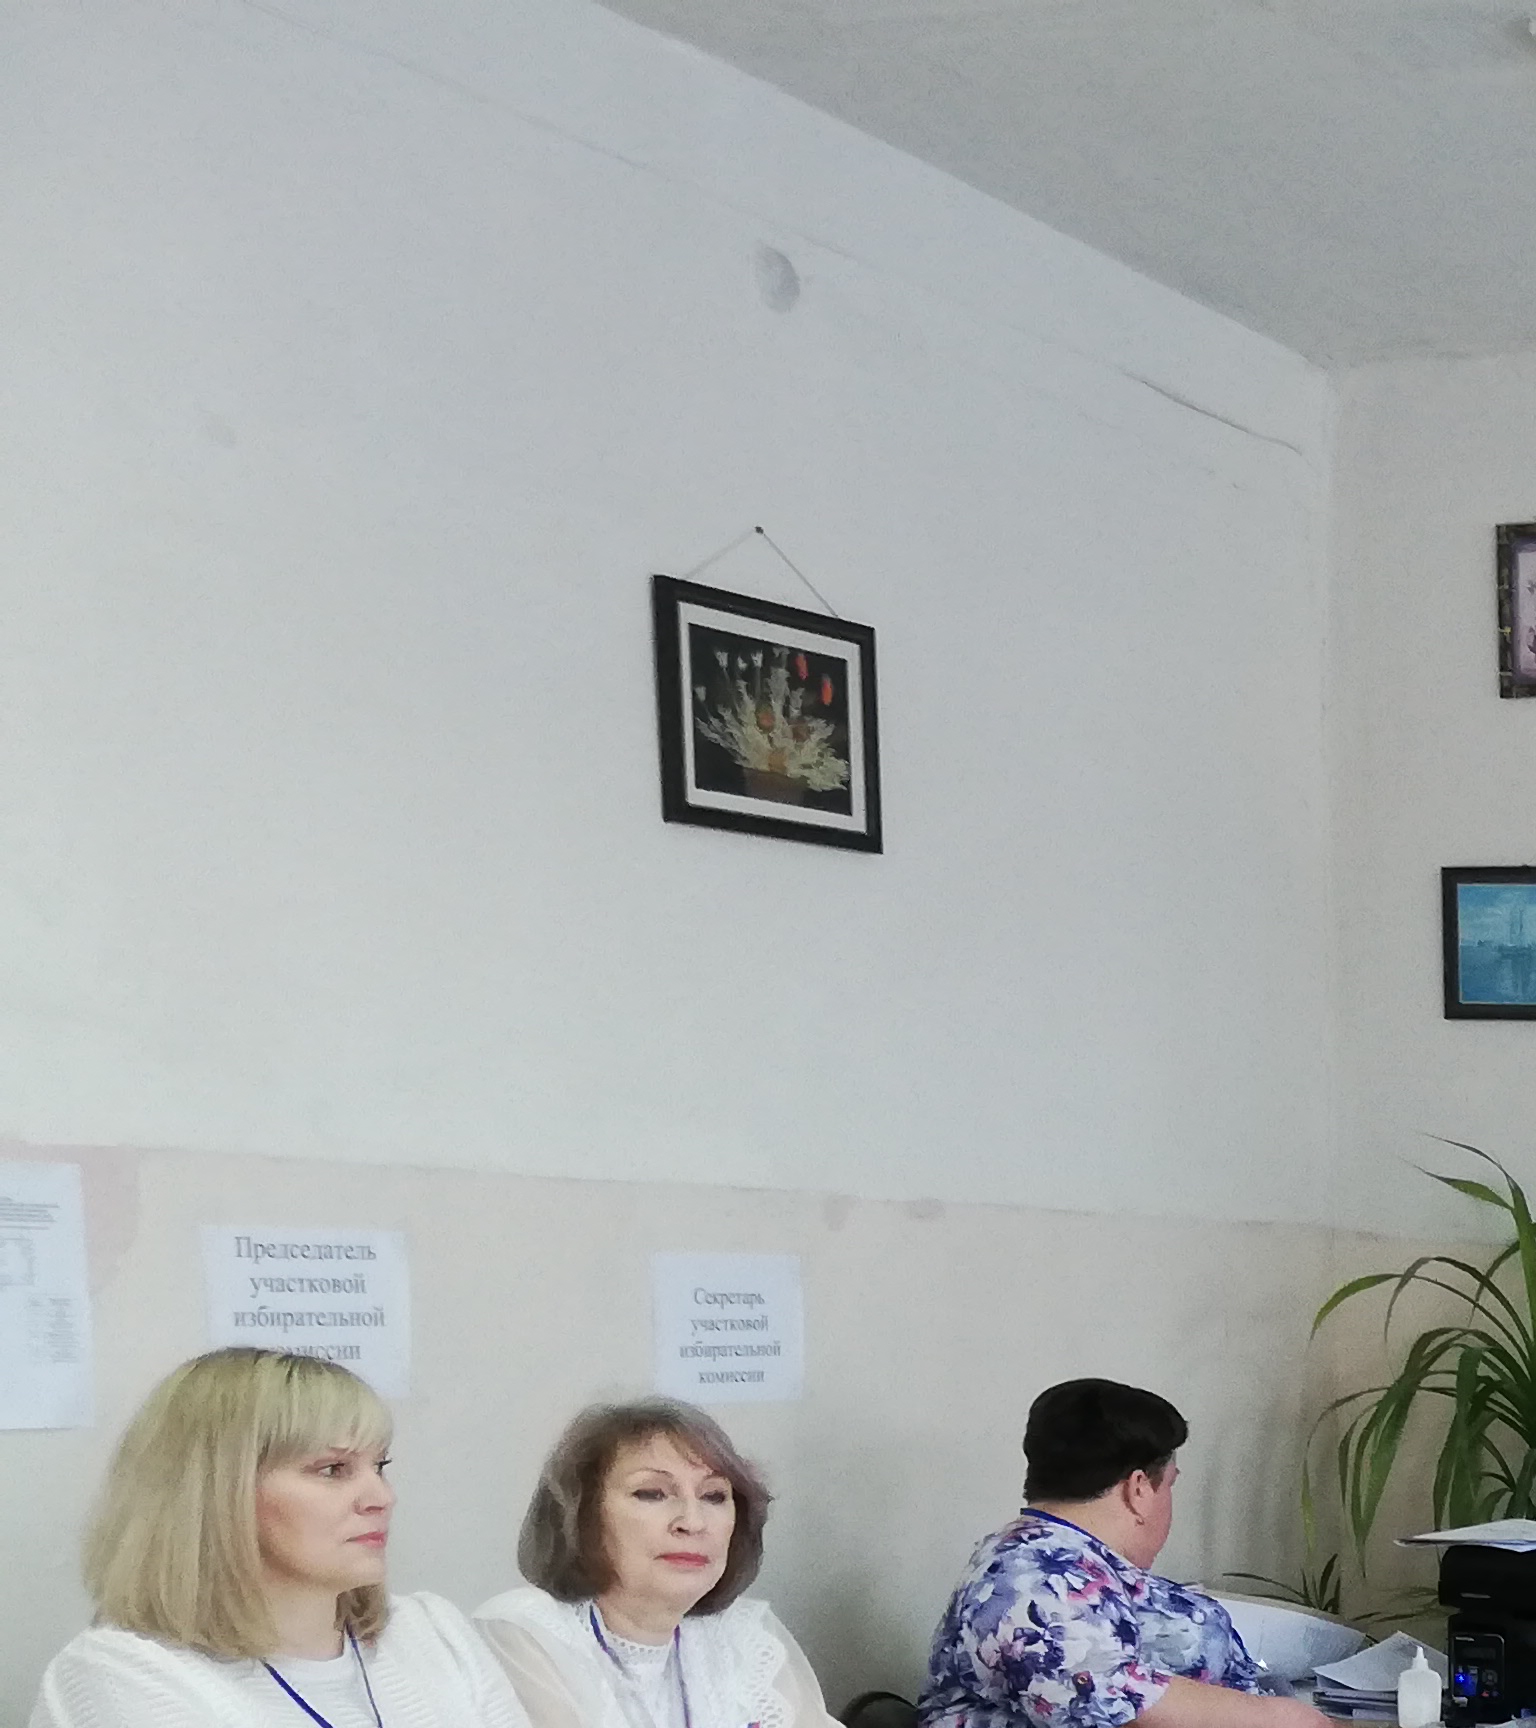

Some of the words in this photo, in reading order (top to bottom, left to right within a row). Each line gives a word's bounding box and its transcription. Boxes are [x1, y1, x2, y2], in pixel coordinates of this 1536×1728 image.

[233, 1235, 378, 1265] Председатель
[249, 1272, 368, 1299] участковой
[693, 1286, 766, 1310] Секретарь
[232, 1304, 386, 1334] избирательной
[690, 1314, 769, 1337] участковой
[679, 1340, 781, 1361] избирательной
[698, 1370, 765, 1383] комиссии
